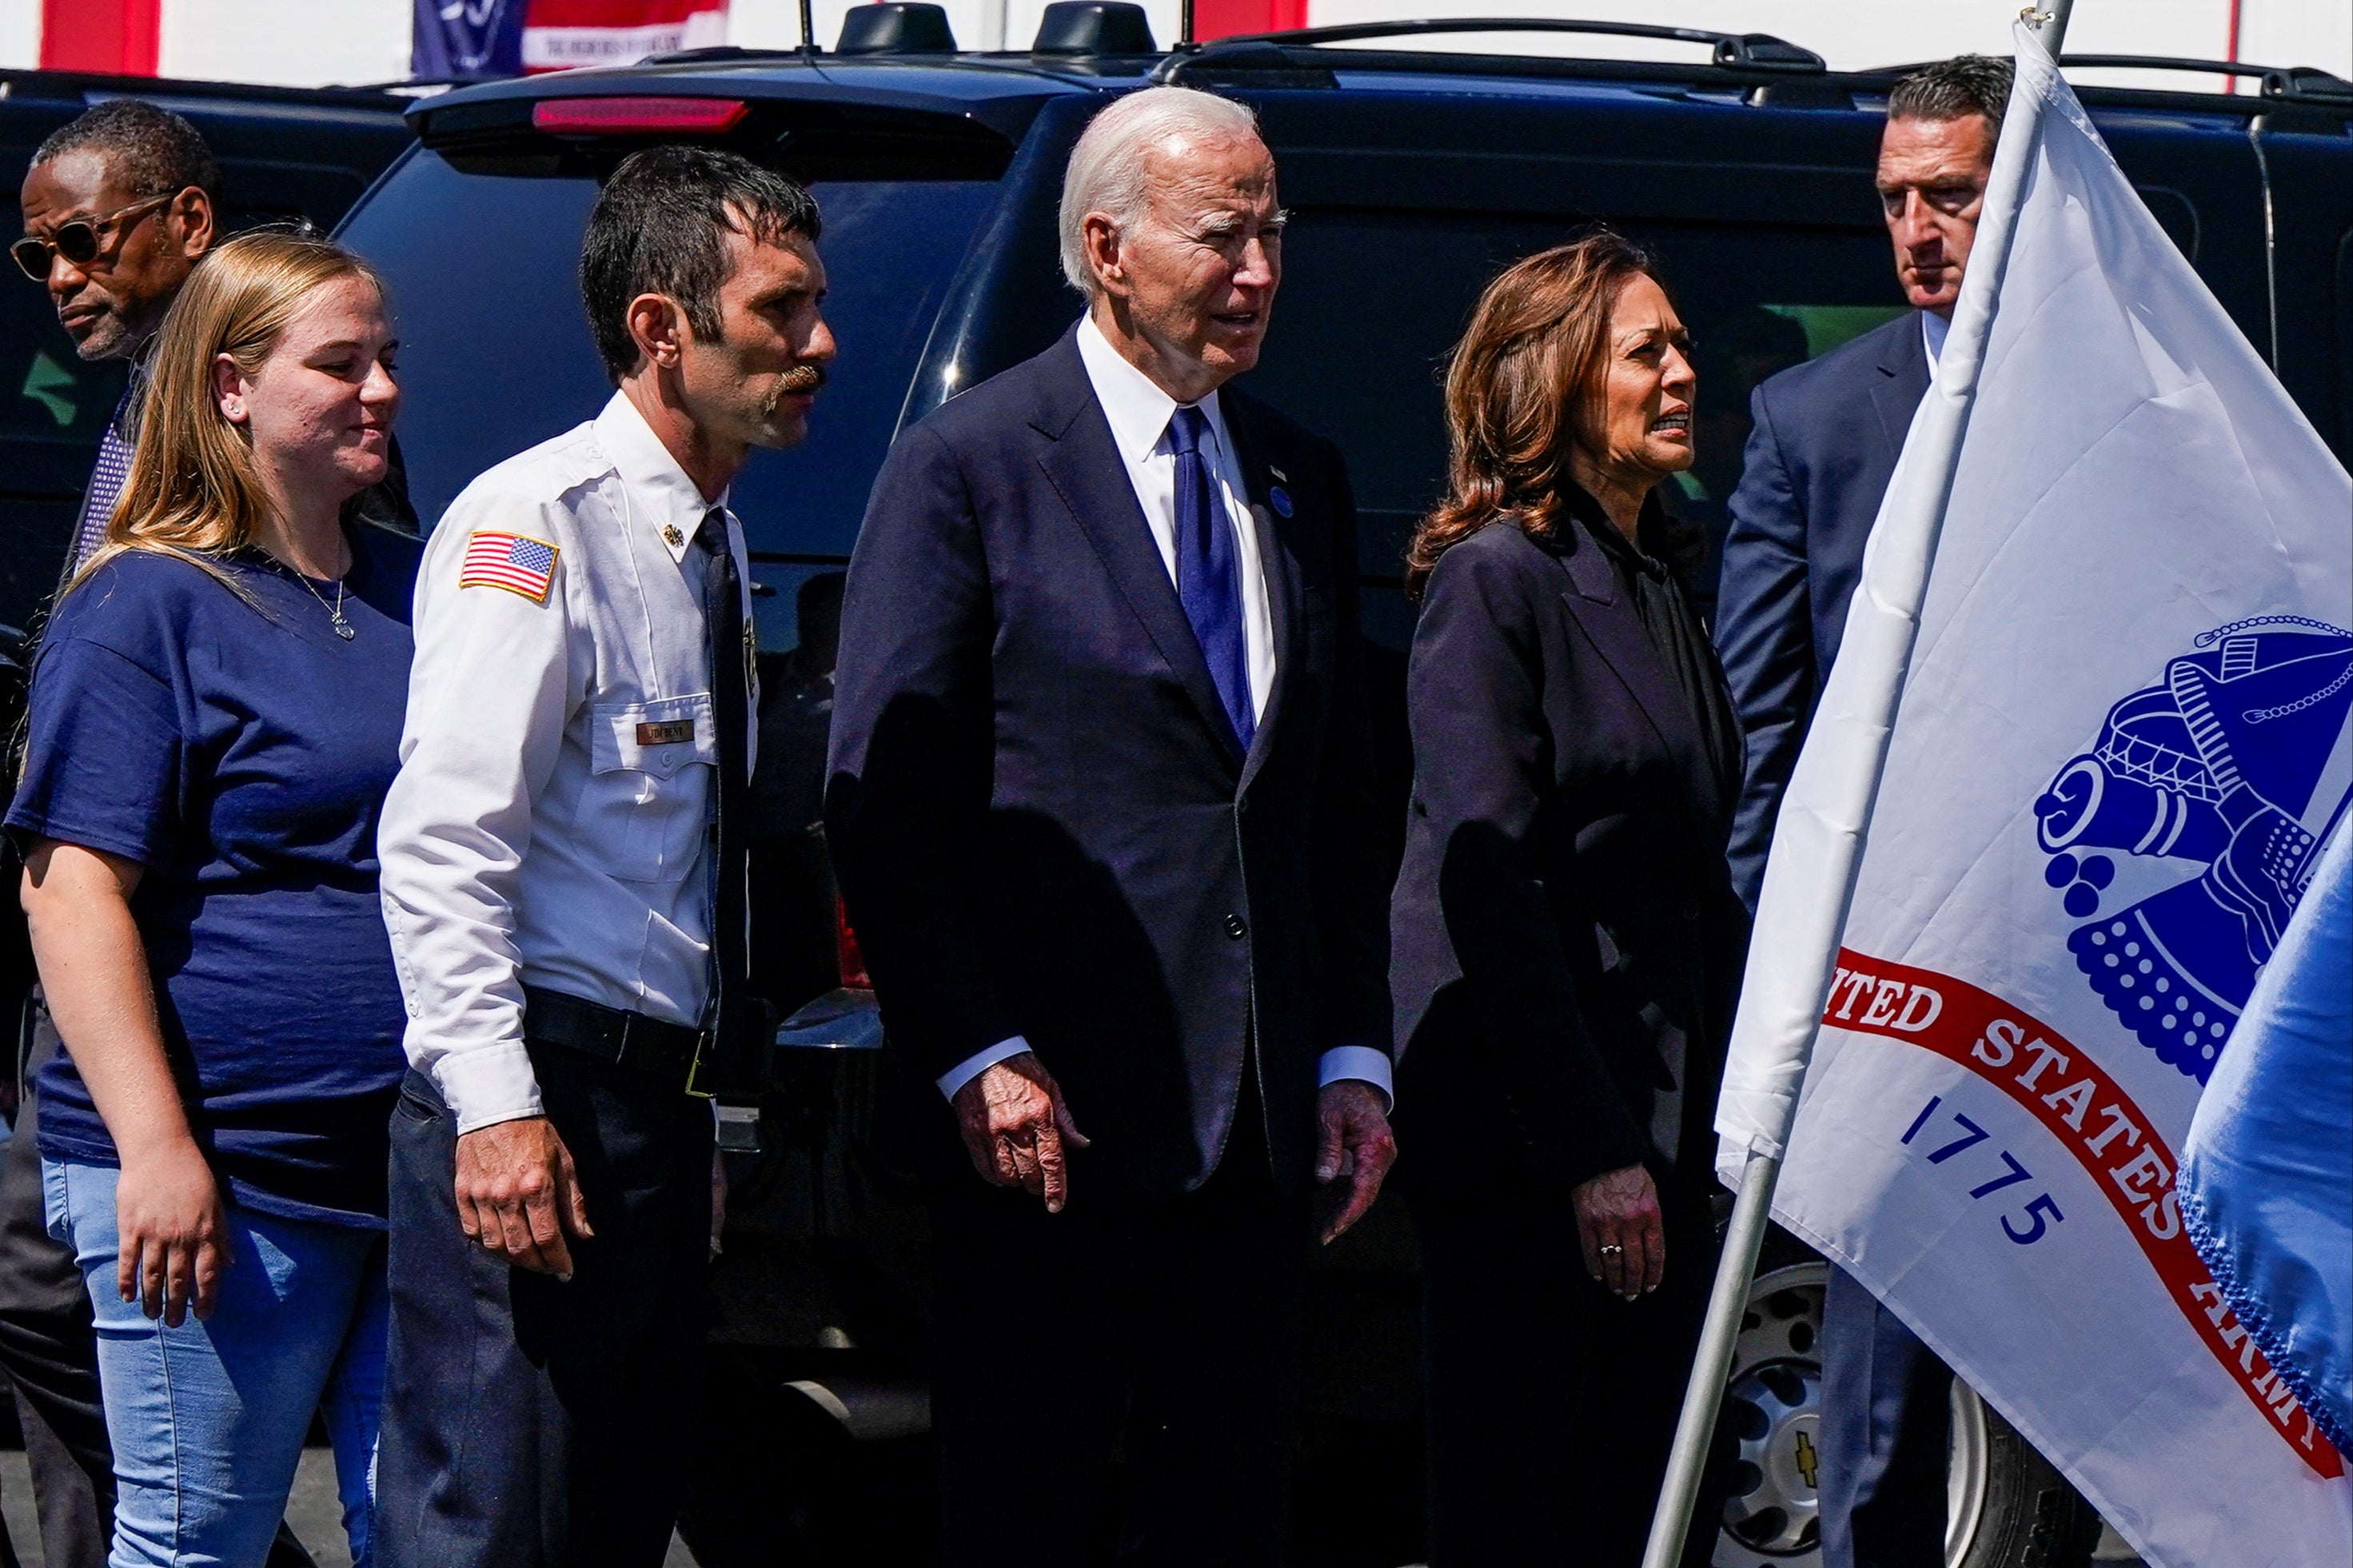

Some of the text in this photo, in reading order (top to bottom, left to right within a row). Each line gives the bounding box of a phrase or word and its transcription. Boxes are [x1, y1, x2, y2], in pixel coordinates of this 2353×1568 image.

[1824, 966, 1944, 1032] ITED
[1970, 1018, 2180, 1240] STATES
[1900, 1095, 2065, 1245] 1775
